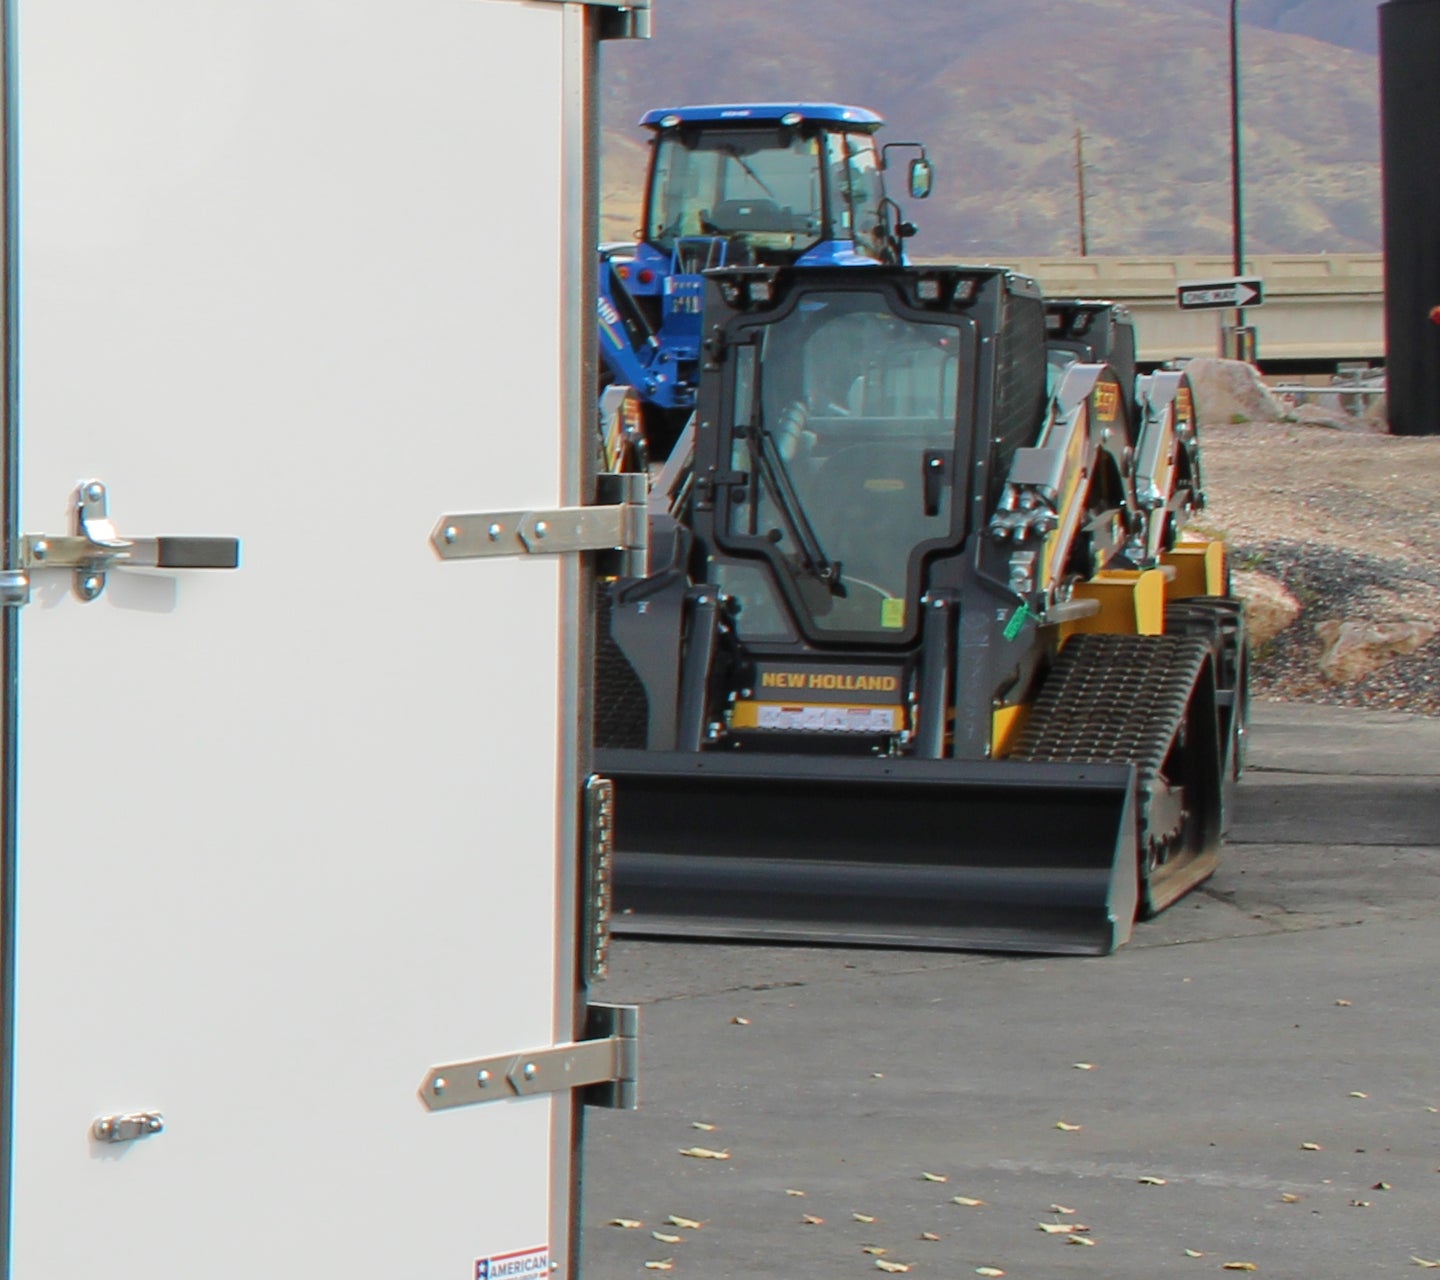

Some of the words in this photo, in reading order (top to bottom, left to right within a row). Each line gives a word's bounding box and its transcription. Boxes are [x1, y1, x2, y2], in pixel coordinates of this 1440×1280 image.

[761, 672, 807, 689] NEW
[809, 673, 898, 691] HOLLAND
[490, 1256, 546, 1278] AMERICAN
